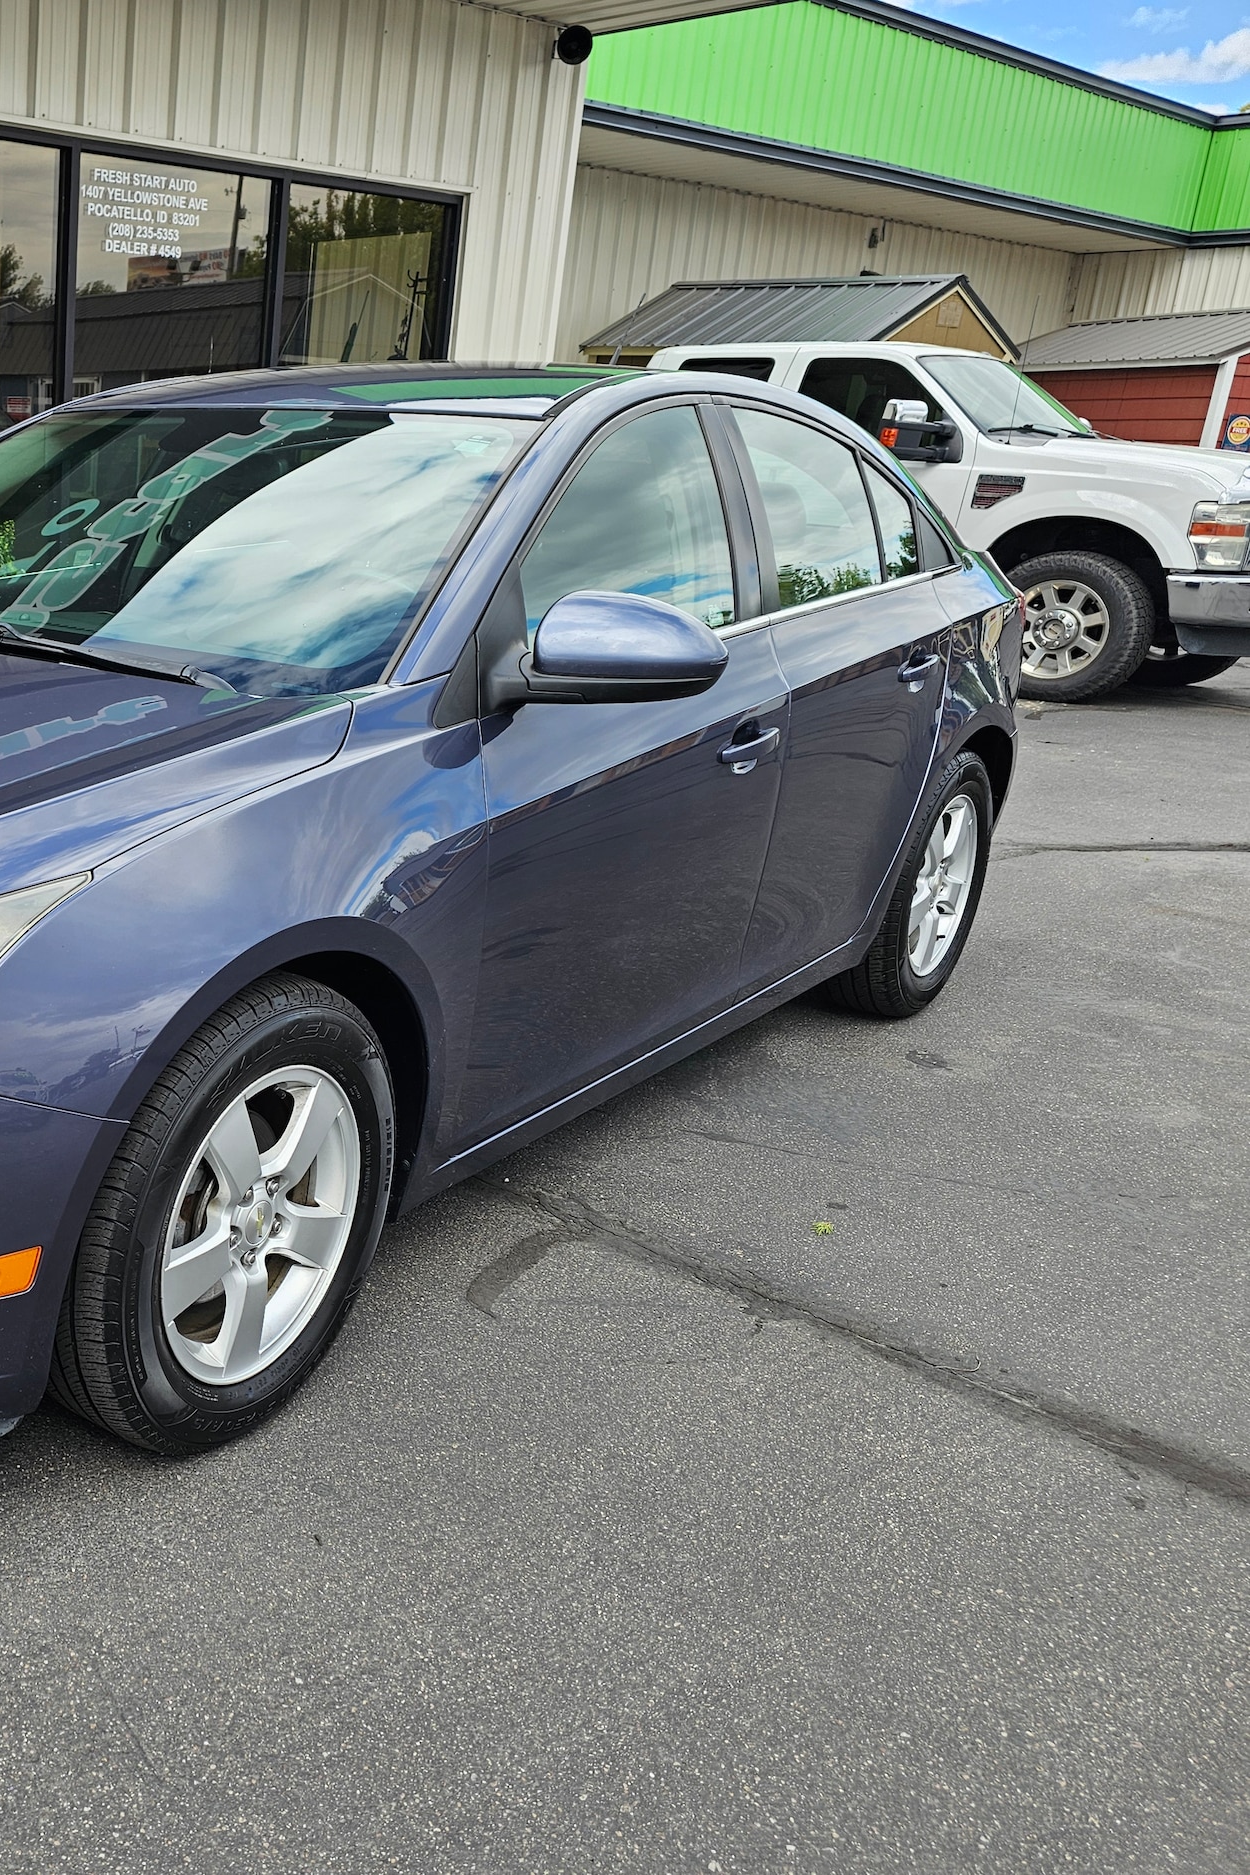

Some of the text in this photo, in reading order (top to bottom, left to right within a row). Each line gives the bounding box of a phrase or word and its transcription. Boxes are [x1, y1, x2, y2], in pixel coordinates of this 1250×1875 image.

[94, 168, 197, 193] FRESH START AUTO
[81, 185, 208, 211] 1407 YELLOWSTONE AVE
[88, 203, 200, 226] POCATELLO, ID 83201
[109, 222, 180, 242] (208) 235-5353
[105, 239, 148, 255] DEALER
[150, 245, 157, 255] #
[158, 245, 182, 259] 4549
